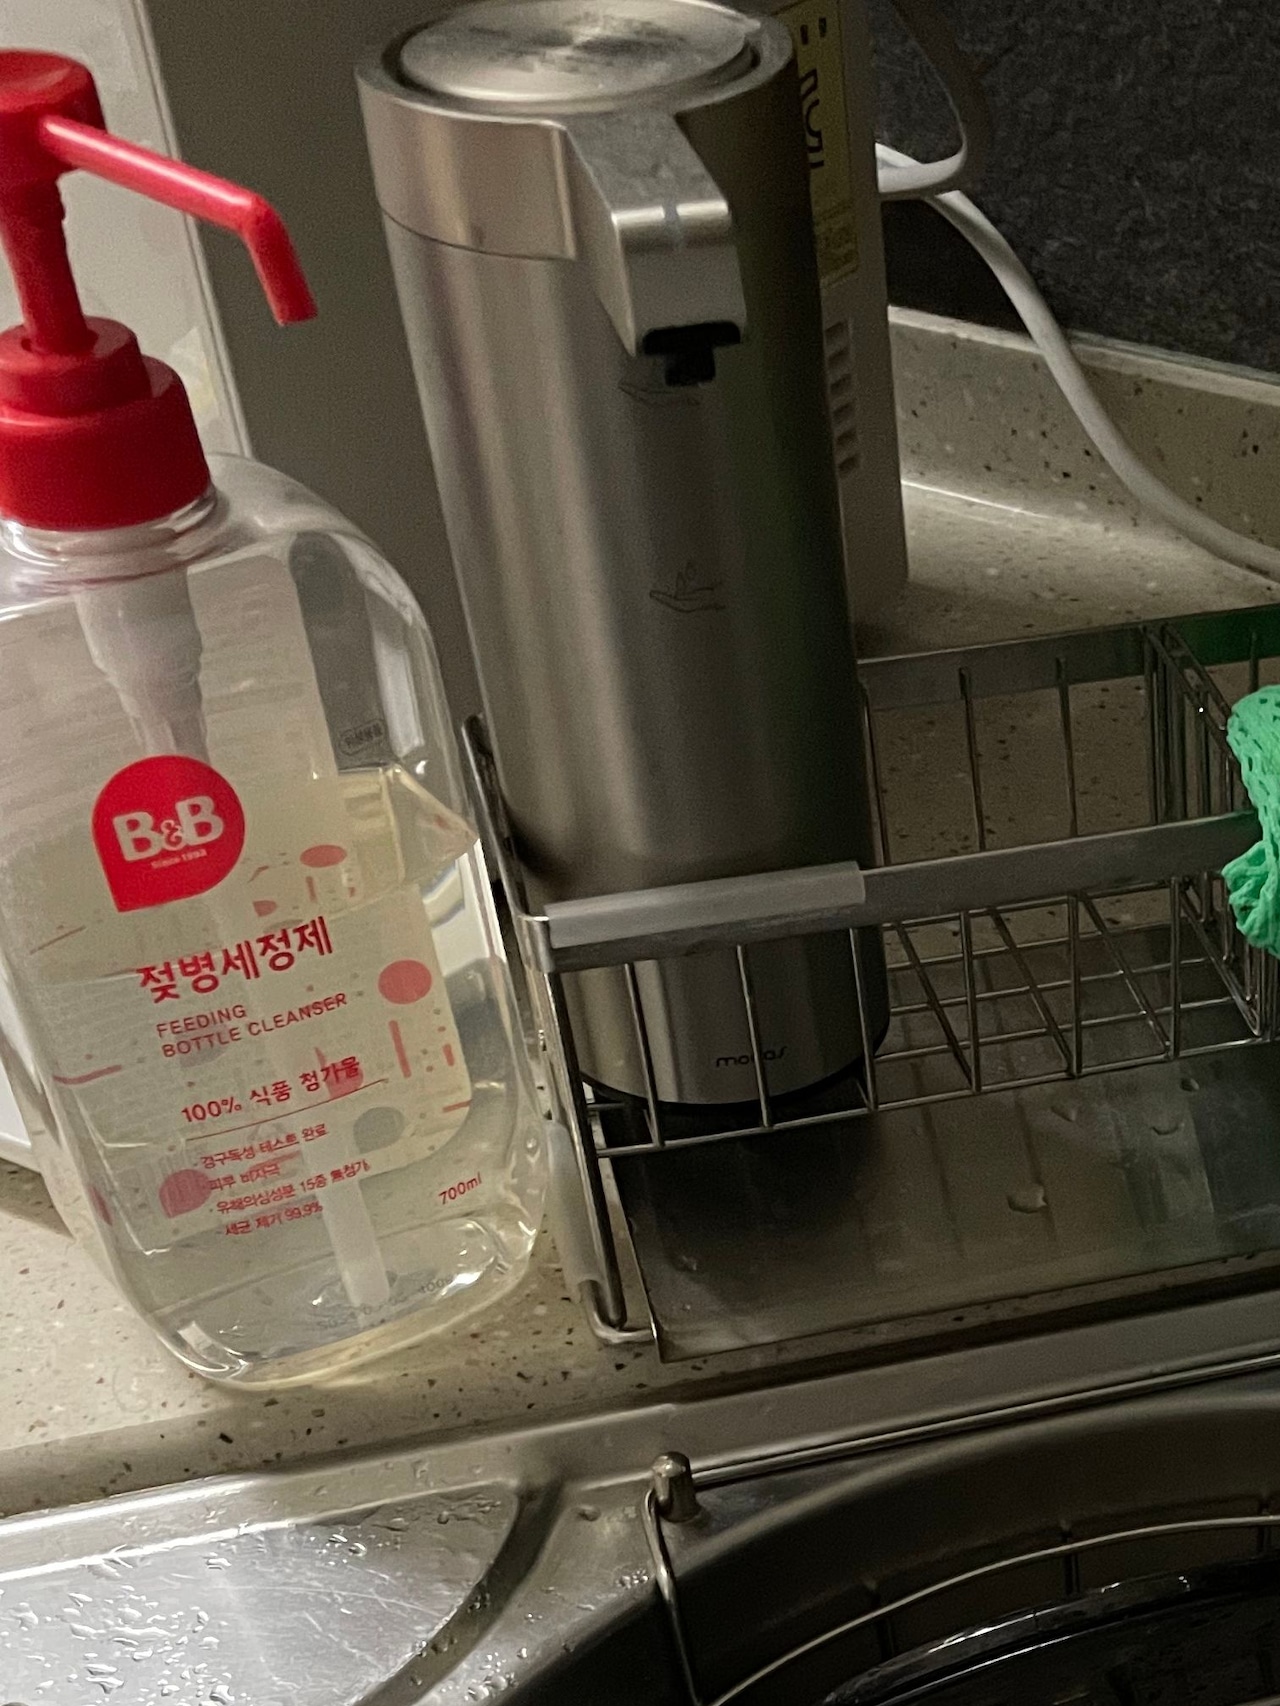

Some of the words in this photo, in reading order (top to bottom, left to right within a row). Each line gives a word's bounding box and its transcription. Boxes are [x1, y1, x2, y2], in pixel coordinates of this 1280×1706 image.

[112, 795, 224, 862] B&B
[136, 915, 333, 1004] 젖병세정제
[157, 1004, 247, 1039] FEEDING
[162, 1027, 242, 1058] BOTTLE
[248, 993, 348, 1037] CLEANSER
[181, 1096, 242, 1123] 100%
[250, 1080, 292, 1106] 식품
[299, 1056, 360, 1092] 첨가물
[259, 1132, 299, 1152] 테스트
[301, 1123, 328, 1142] 완료
[284, 1201, 323, 1220] 99.9%
[438, 1170, 484, 1206] 700ml
